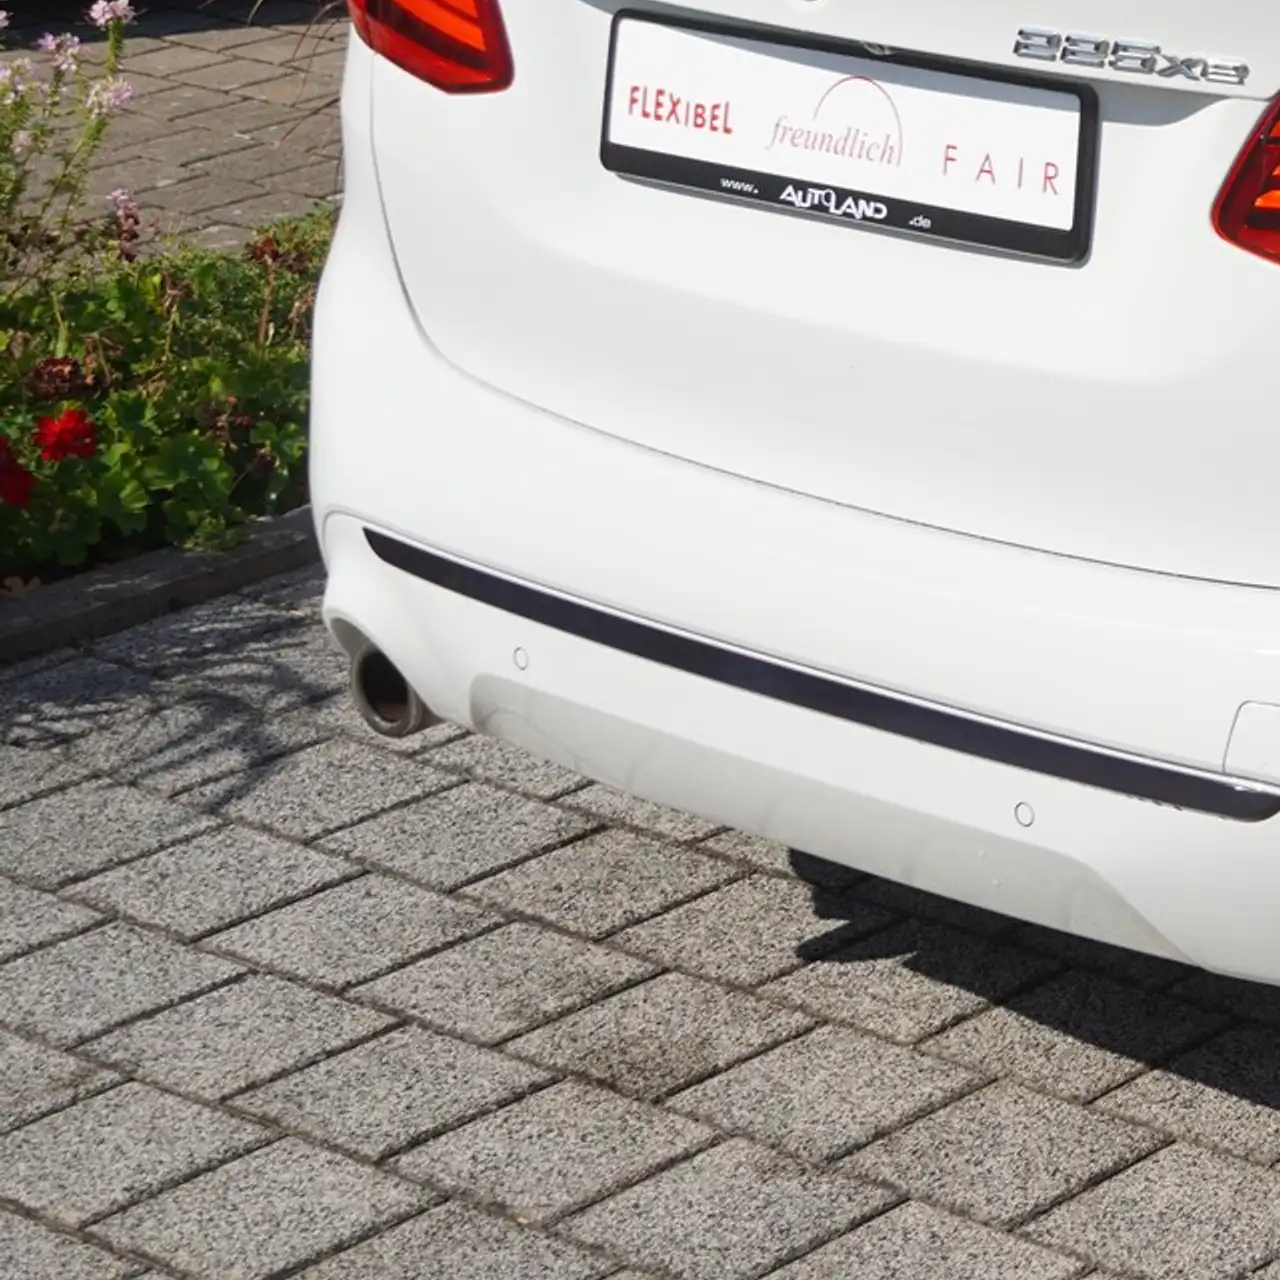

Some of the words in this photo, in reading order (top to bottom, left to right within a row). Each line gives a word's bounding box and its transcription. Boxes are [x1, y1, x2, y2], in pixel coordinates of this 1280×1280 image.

[1012, 24, 1251, 86] 225xe
[628, 84, 733, 135] FLEXIBEL
[764, 115, 896, 165] freundlich
[942, 144, 1060, 196] FAIR
[780, 184, 888, 219] AUTOLAND
